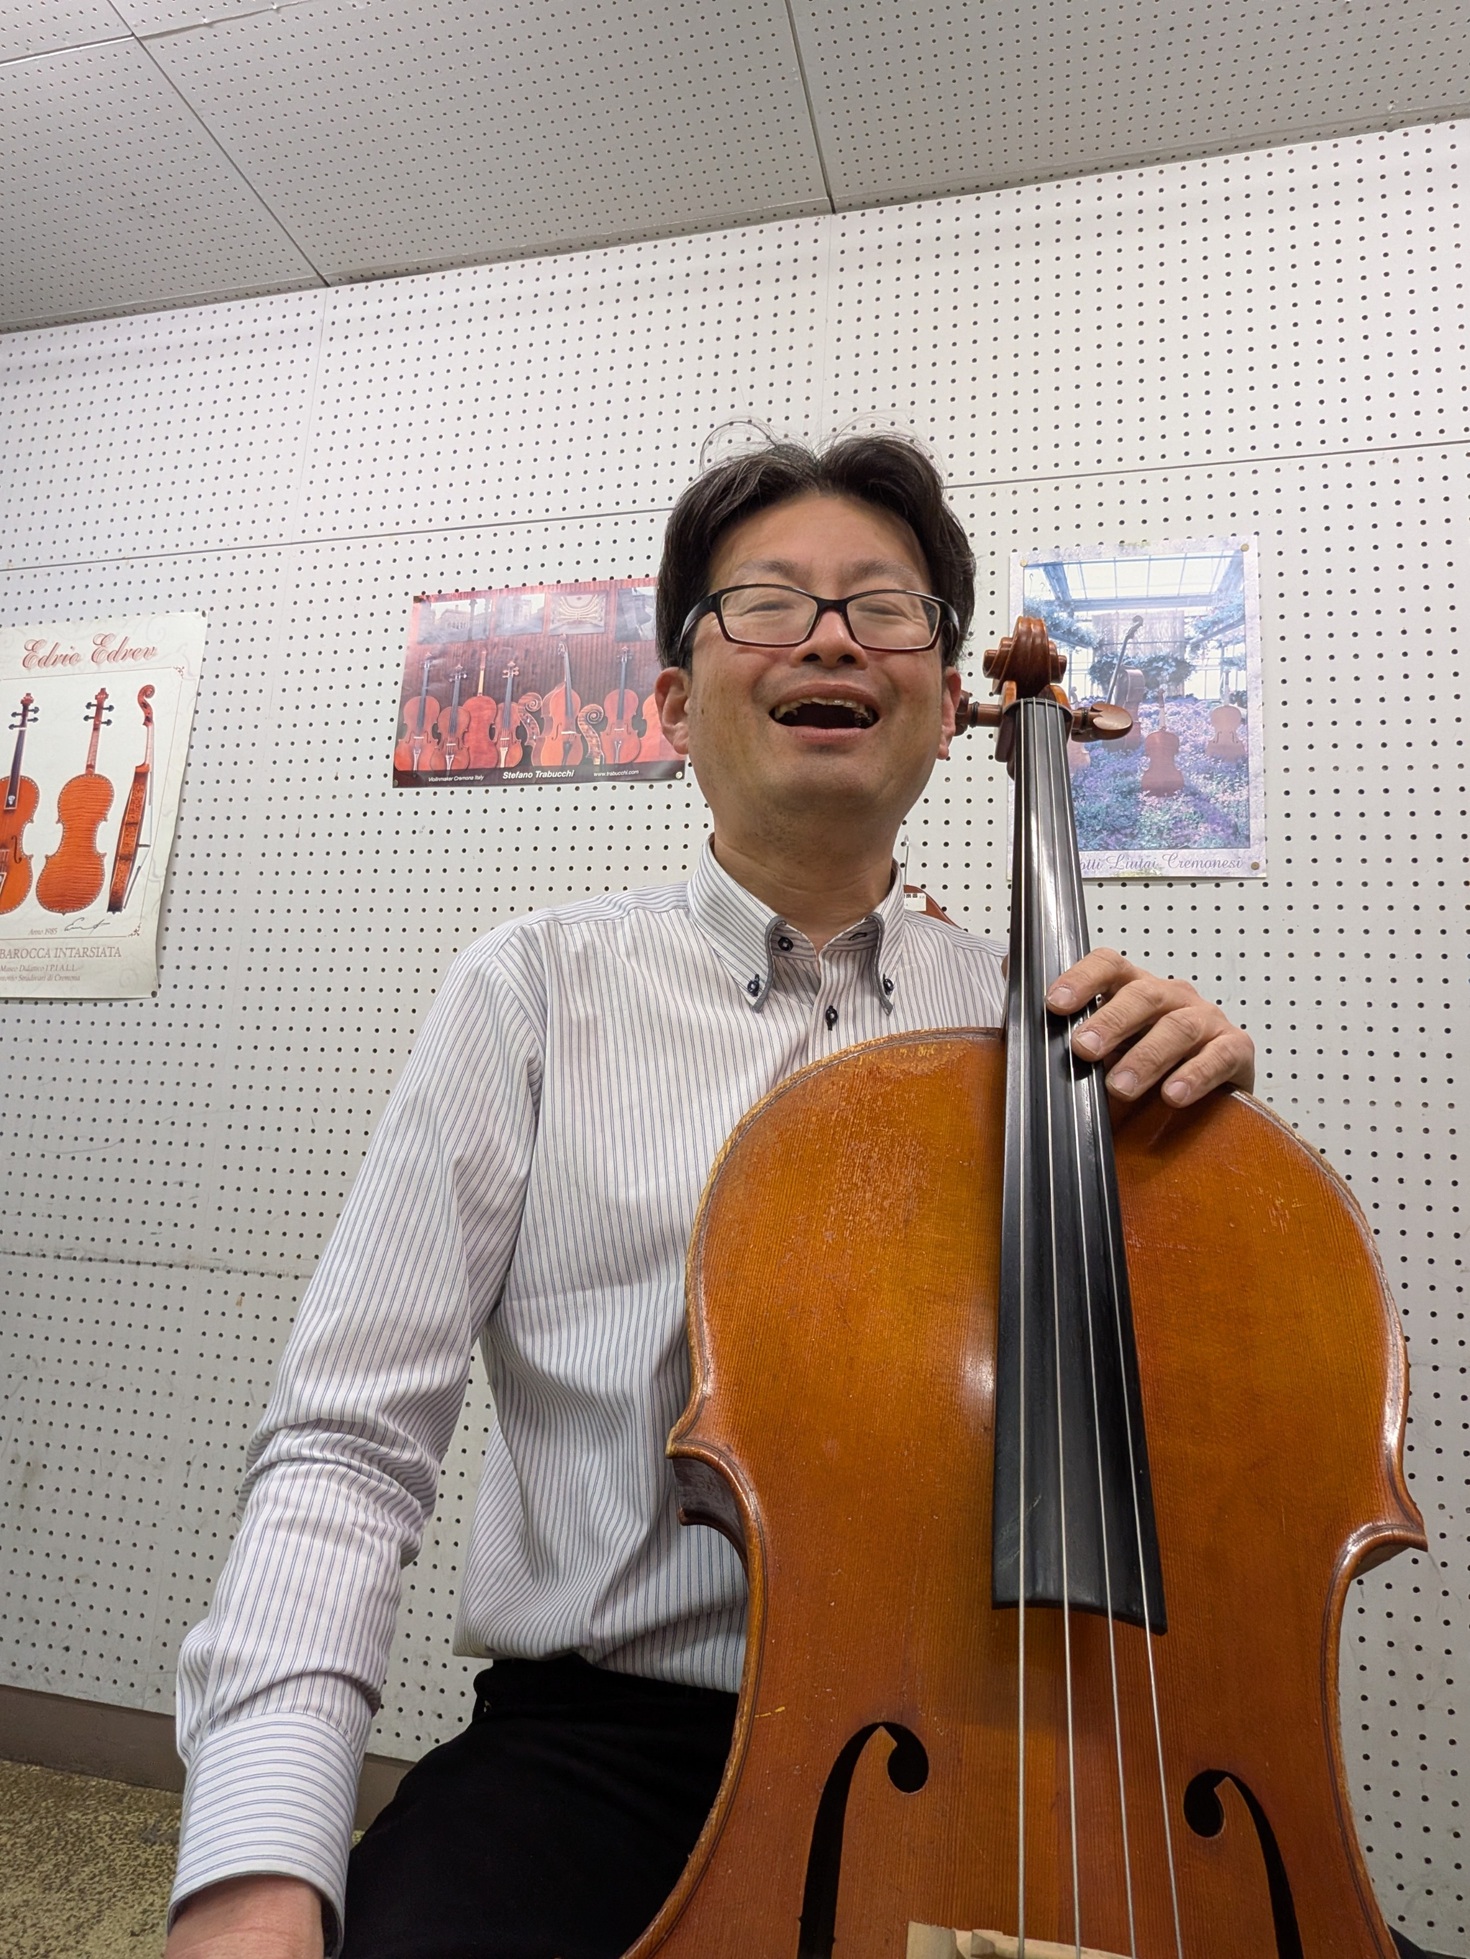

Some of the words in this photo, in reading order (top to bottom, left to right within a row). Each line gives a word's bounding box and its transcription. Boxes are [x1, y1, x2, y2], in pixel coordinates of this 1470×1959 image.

[502, 771, 534, 780] Stefano
[535, 769, 575, 779] Trabucchi
[593, 769, 640, 778] www.trabucchi.com
[1106, 854, 1158, 870] Liutai
[1161, 852, 1244, 869] Cremonesi
[0, 947, 51, 959] BAROCCA
[53, 946, 122, 958] INTARSIATA
[54, 973, 81, 982] Cremona
